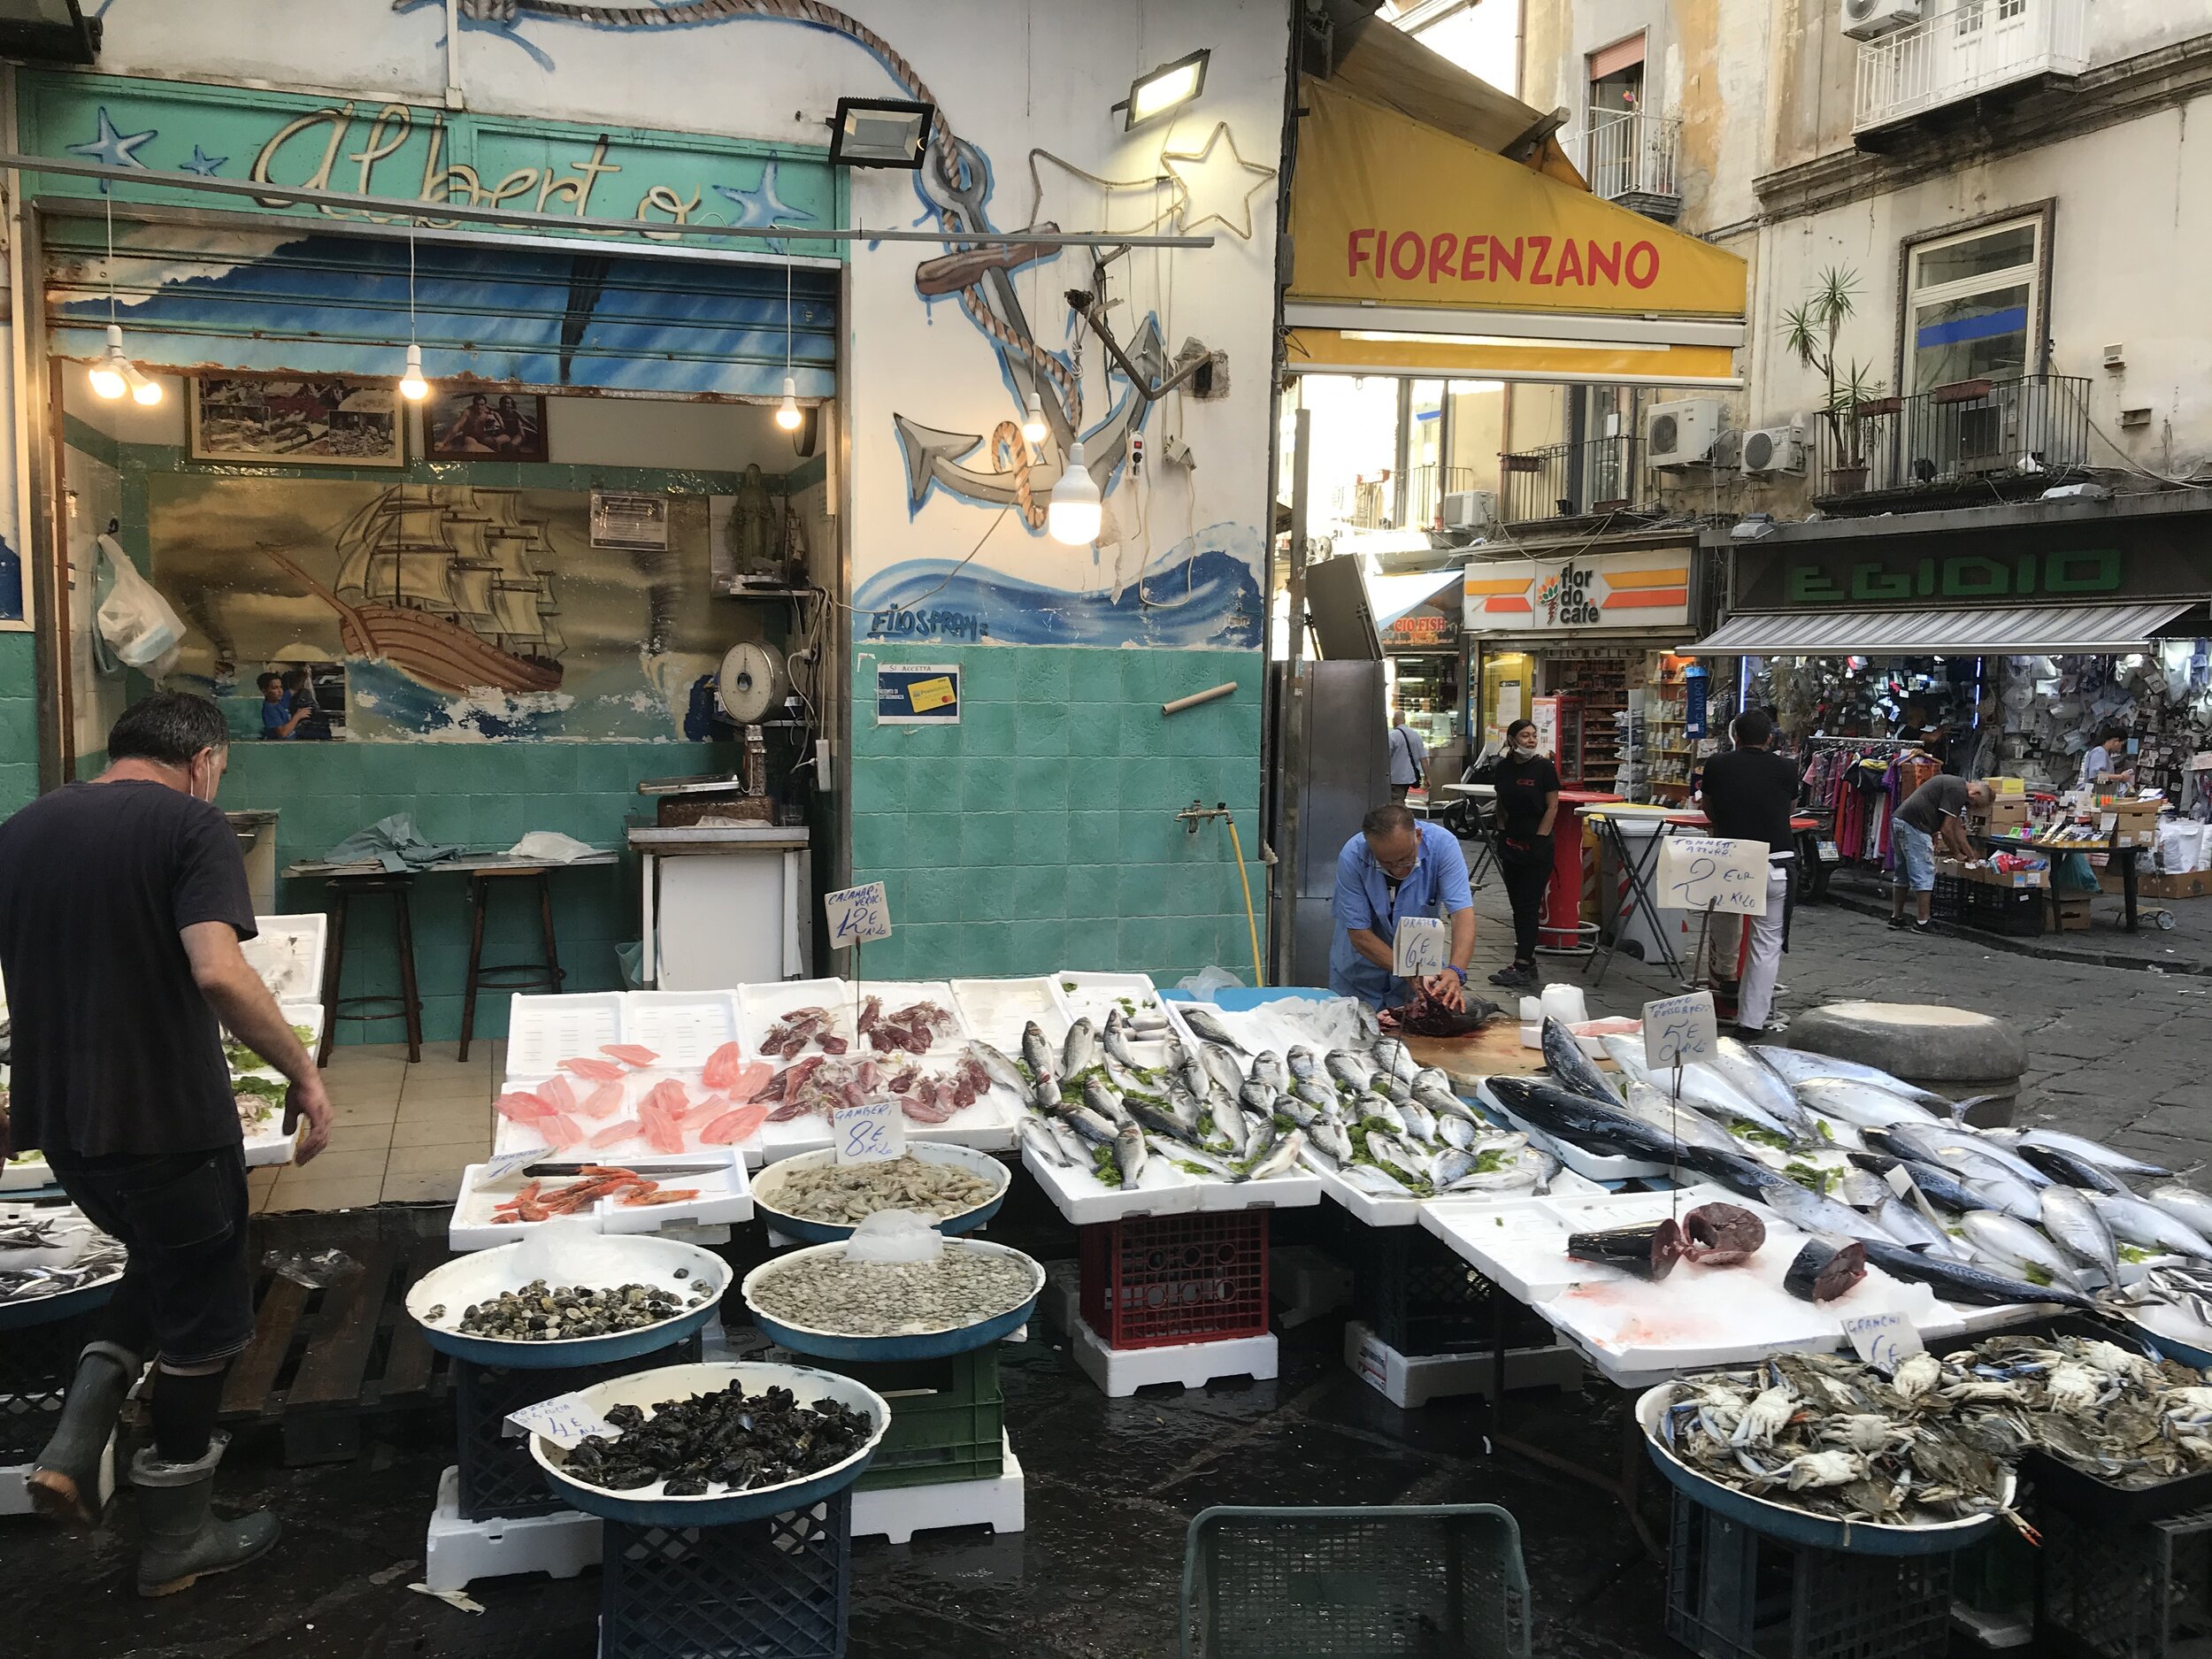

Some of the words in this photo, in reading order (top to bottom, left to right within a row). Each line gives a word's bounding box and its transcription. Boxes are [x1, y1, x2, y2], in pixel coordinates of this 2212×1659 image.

[1348, 228, 1660, 289] FIORENZANO
[1561, 563, 1593, 589] flor
[1791, 549, 2122, 602] EGIDIO
[1561, 587, 1584, 607] do
[1417, 617, 1447, 632] FISH
[1671, 857, 1716, 907] 2
[836, 907, 868, 938] 12
[1405, 933, 1422, 968] 6
[1649, 996, 1692, 1013] TONNO
[1659, 1018, 1689, 1062] 5
[845, 1120, 873, 1156] 8
[549, 1417, 578, 1437] 4
